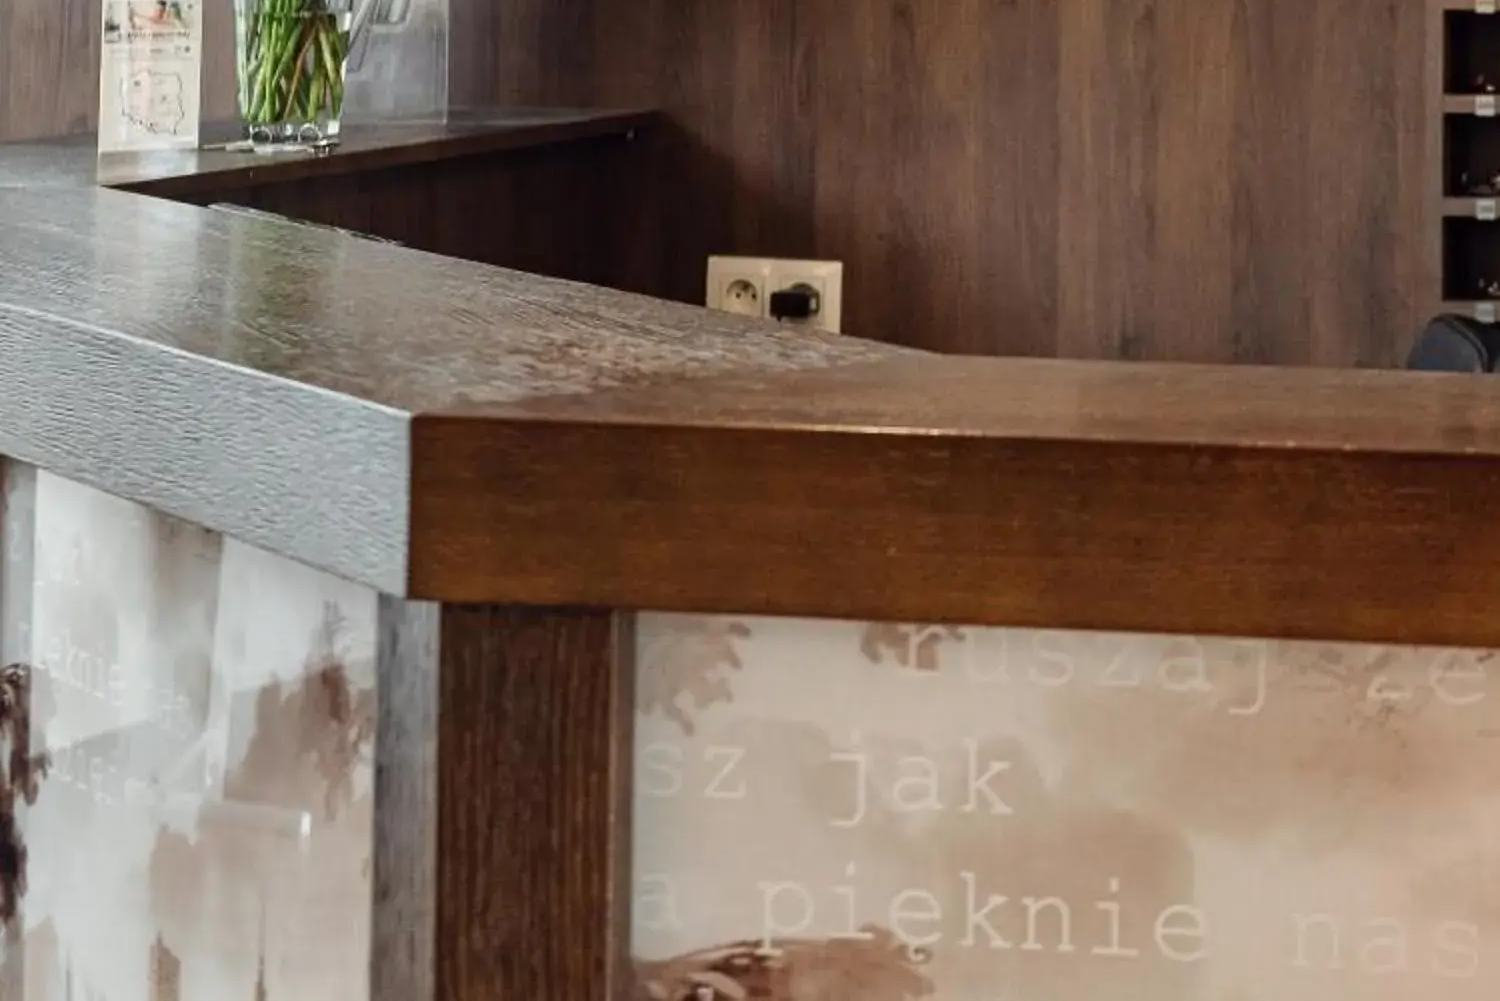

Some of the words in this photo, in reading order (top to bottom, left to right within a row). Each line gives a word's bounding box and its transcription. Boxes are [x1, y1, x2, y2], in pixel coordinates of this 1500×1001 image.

[829, 729, 1015, 828] jak
[757, 862, 1209, 963] pięknie
[1288, 911, 1481, 979] nas
